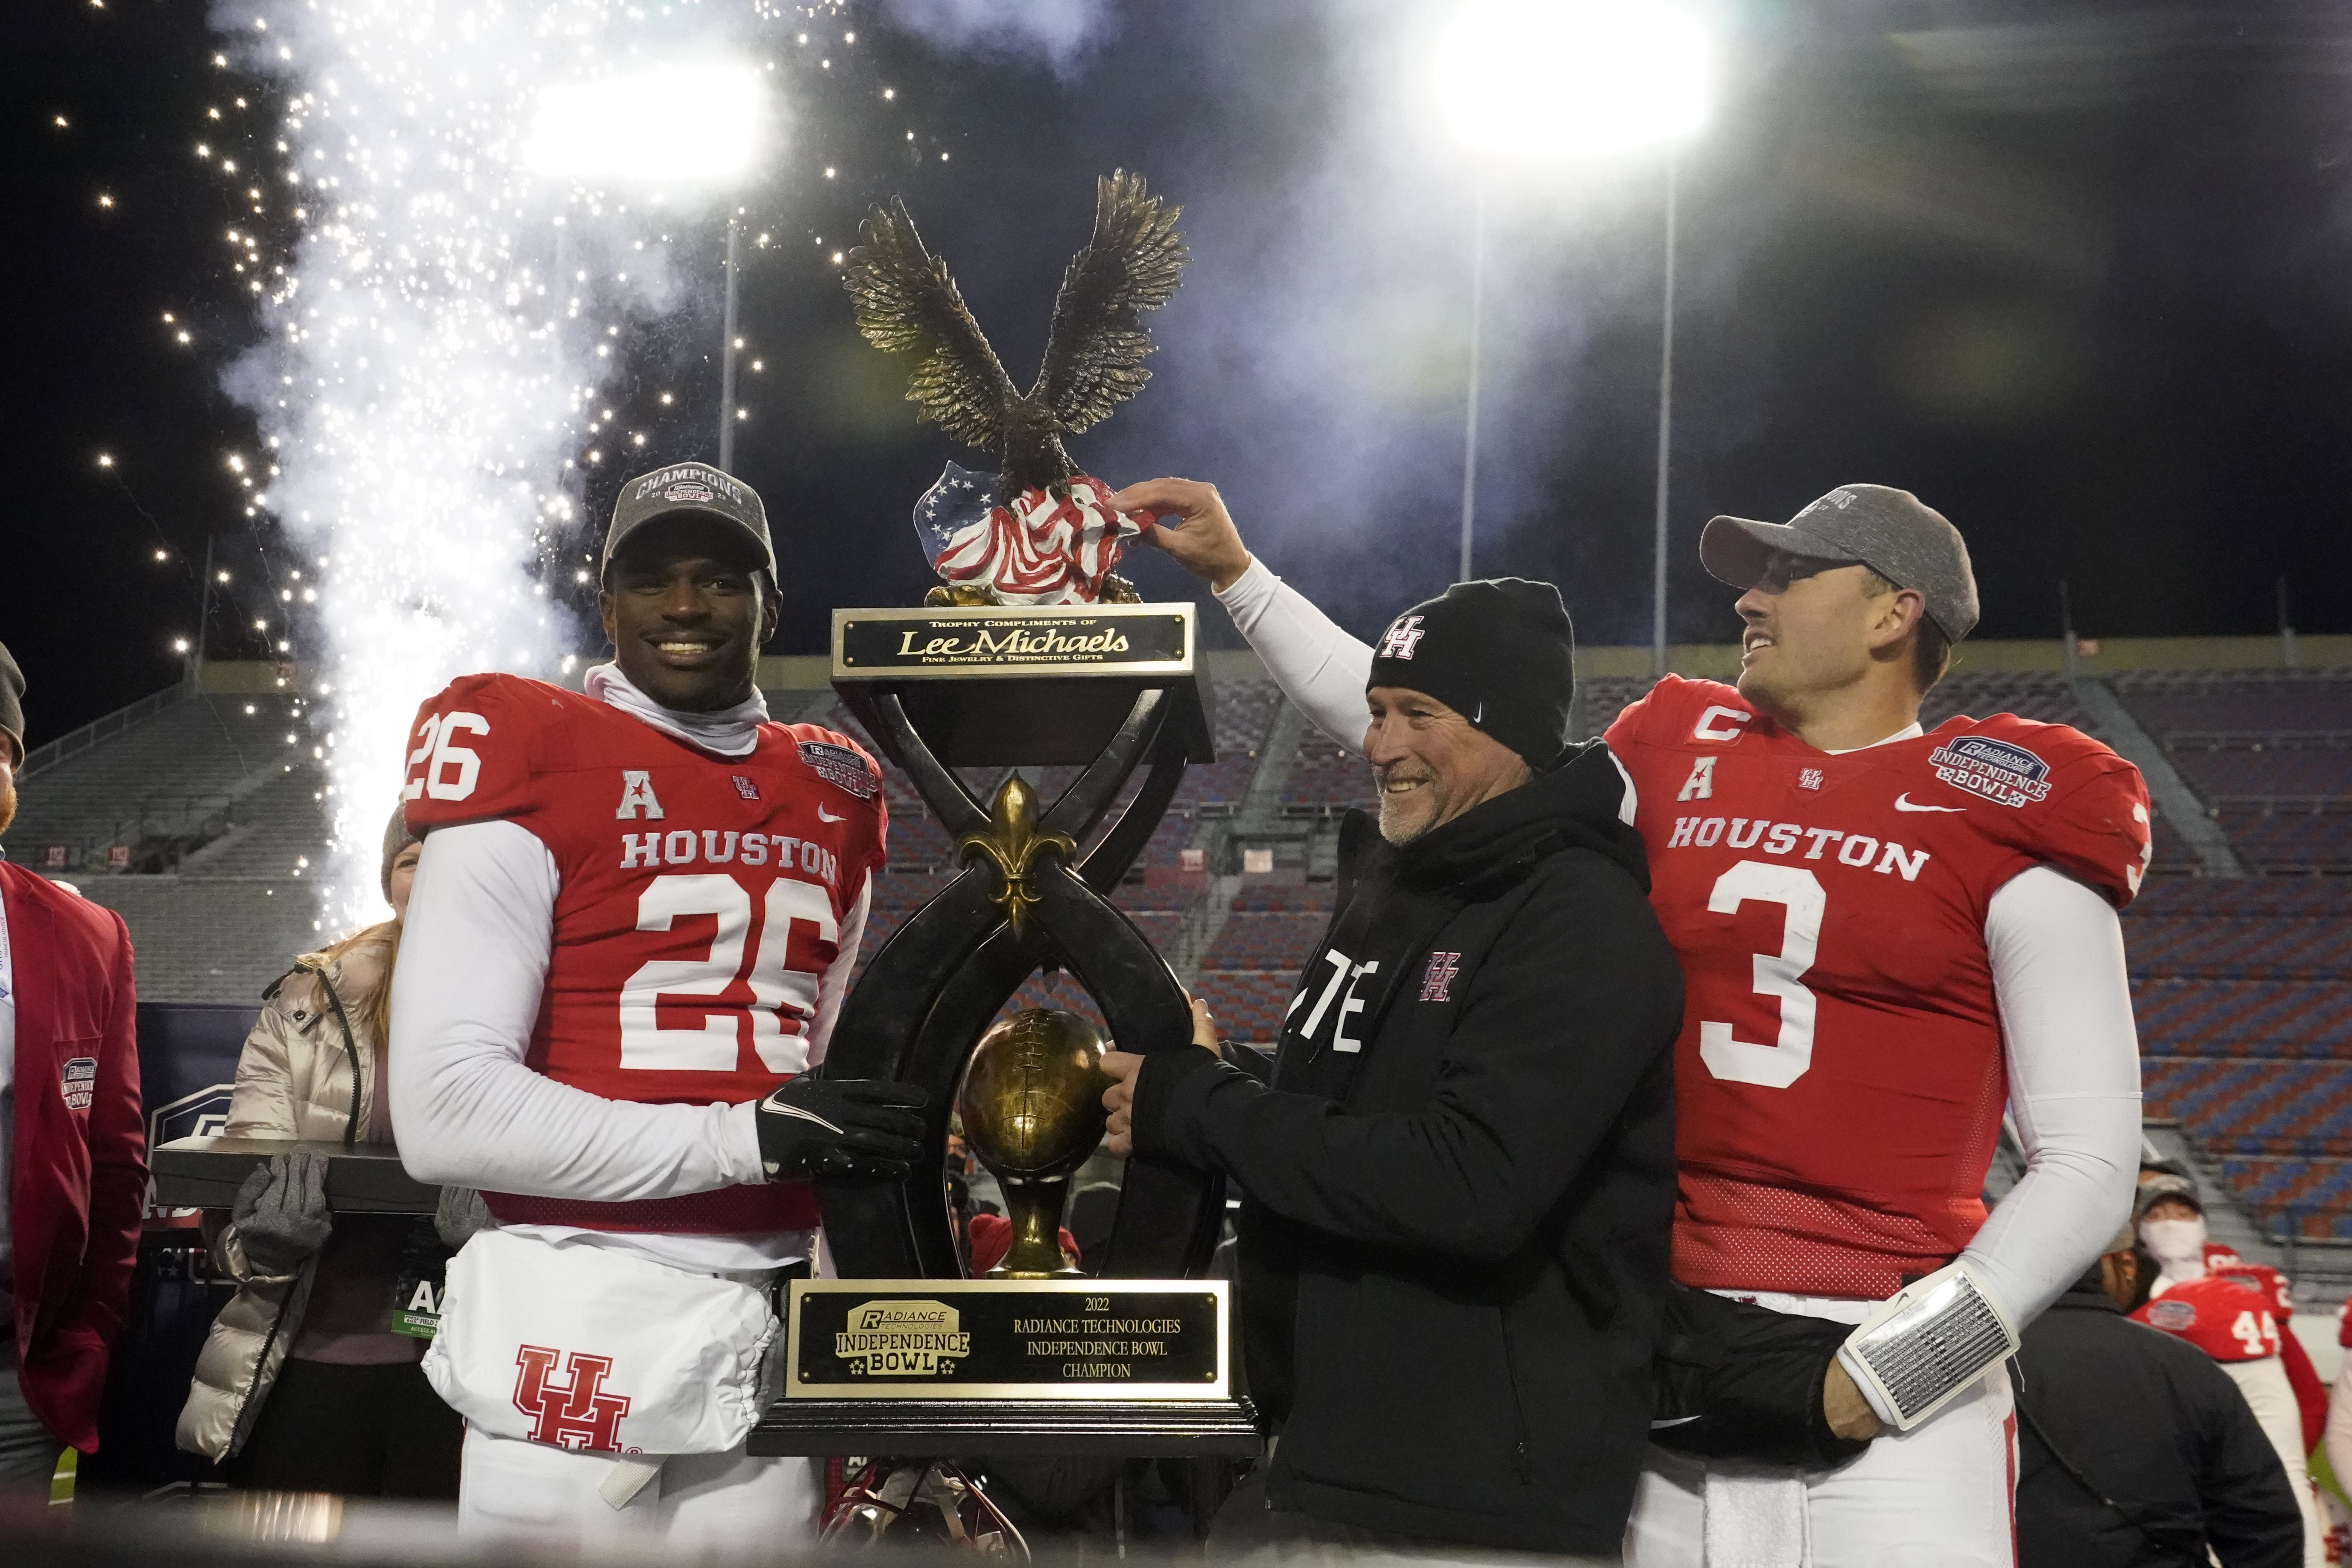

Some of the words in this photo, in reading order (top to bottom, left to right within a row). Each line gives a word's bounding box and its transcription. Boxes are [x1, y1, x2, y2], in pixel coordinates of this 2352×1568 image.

[635, 468, 742, 505] CHAMPIONS
[666, 489, 713, 499] INDEPENDENCE
[717, 492, 726, 501] 22
[897, 631, 976, 655] Lee
[969, 628, 1129, 653] Michaels
[1693, 705, 1752, 741] C
[404, 710, 490, 801] 26
[1958, 741, 2038, 769] RADIANCE
[1976, 753, 2032, 775] TECHNOLOGIES
[1677, 755, 1718, 802] A
[1932, 749, 2047, 798] INDEPENDENCE
[1953, 769, 2007, 800] BOWL
[616, 770, 665, 820] A
[620, 829, 837, 884] HOUSTON
[1666, 817, 1931, 882] HOUSTON
[619, 873, 838, 1074] 26
[1699, 859, 1827, 1089] 3
[1285, 948, 1379, 1053] TE
[1085, 1297, 1109, 1311] 2022
[860, 1310, 947, 1329] RADIANCE
[1014, 1319, 1079, 1333] RADIANCE
[1082, 1319, 1181, 1333] TECHNOLOGIES
[838, 1334, 968, 1353] INDEPENDENCE
[1027, 1341, 1129, 1356] INDEPENDENCE
[1131, 1341, 1167, 1356] BOWL
[870, 1352, 935, 1370] BOWL
[1063, 1363, 1131, 1377] CHAMPION
